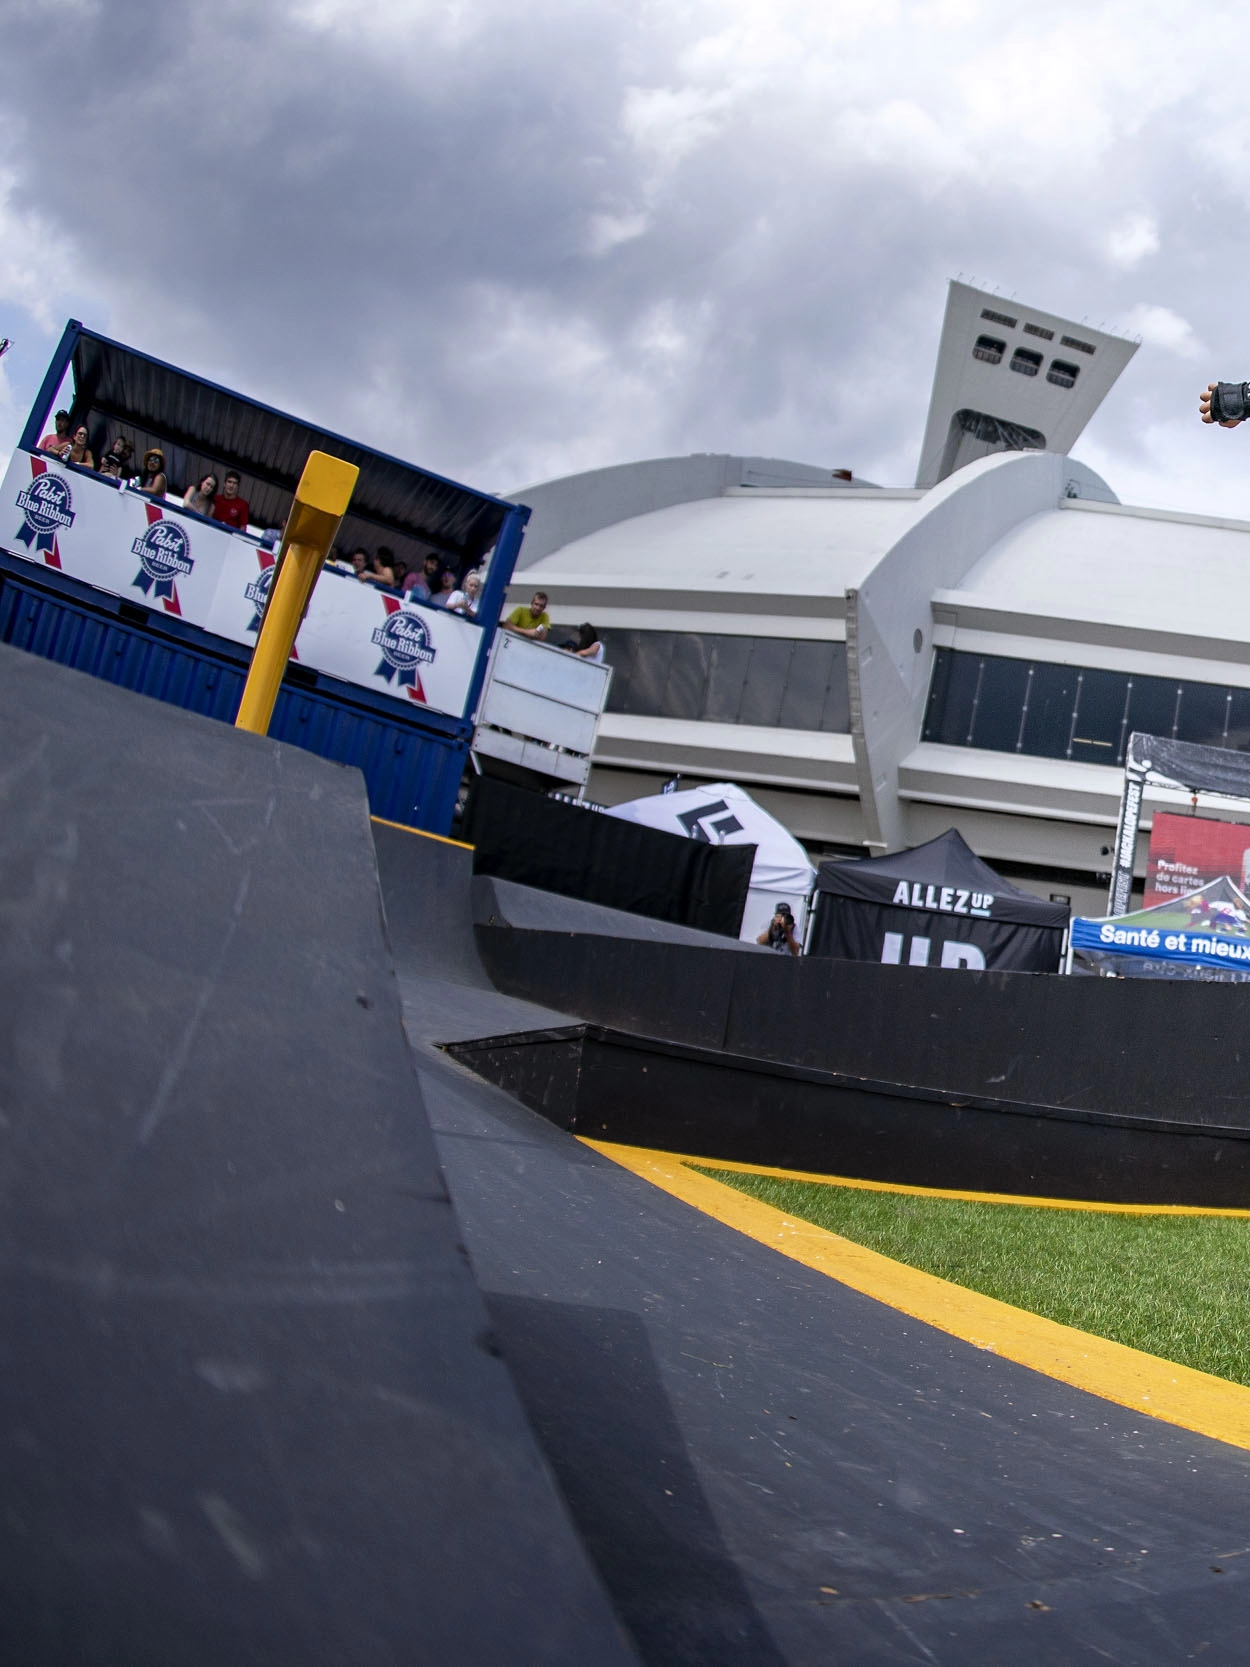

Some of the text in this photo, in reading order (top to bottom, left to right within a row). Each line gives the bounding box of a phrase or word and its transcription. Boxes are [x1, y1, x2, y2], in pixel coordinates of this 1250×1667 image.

[34, 479, 66, 505] Pabst
[17, 492, 72, 526] Blue Ribbon
[150, 526, 183, 552] Pabst
[133, 539, 191, 573] Blue Ribbon
[390, 616, 423, 642] Pabst
[373, 630, 433, 662] Blue Ribbon
[1156, 872, 1205, 887] de cartes
[1157, 859, 1199, 875] Profitez
[1155, 882, 1179, 895] hors
[1100, 924, 1160, 949] Santé
[1165, 933, 1187, 952] et
